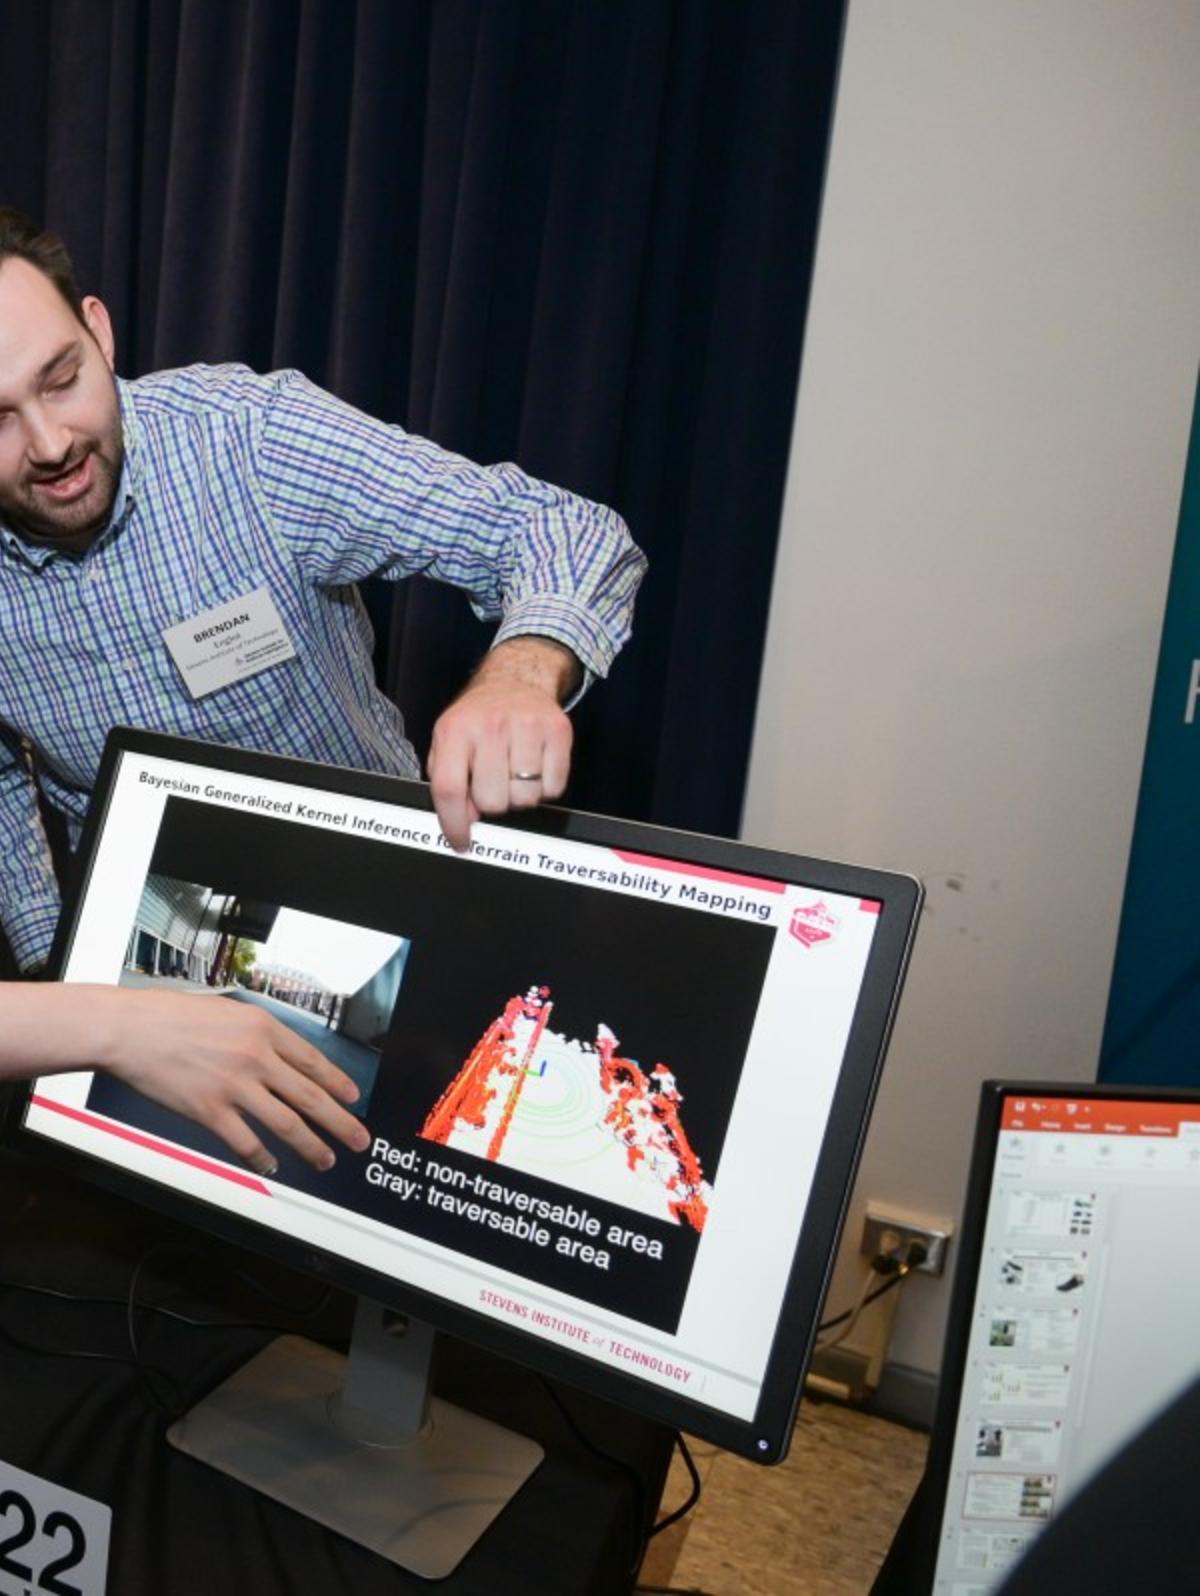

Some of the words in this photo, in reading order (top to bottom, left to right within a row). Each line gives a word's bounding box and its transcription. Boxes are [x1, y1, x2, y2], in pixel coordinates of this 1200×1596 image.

[193, 613, 251, 643] BRENDAN
[138, 770, 201, 795] Bayesian
[204, 785, 292, 815] Generalized
[295, 804, 349, 828] Kernel
[352, 815, 432, 846] Inference
[468, 839, 531, 865] Terrain
[536, 853, 674, 899] Traversability
[678, 884, 773, 921] Mapping
[365, 1163, 423, 1200] Gray:
[427, 1185, 551, 1248] traversable
[555, 1235, 612, 1270] area
[371, 1137, 422, 1173] Red:
[425, 1160, 601, 1237] non-traversable
[606, 1224, 665, 1261] area
[479, 1288, 529, 1319] STEVENS
[531, 1309, 591, 1344] INSTITUTE
[609, 1340, 692, 1384] TECHNOLOGY
